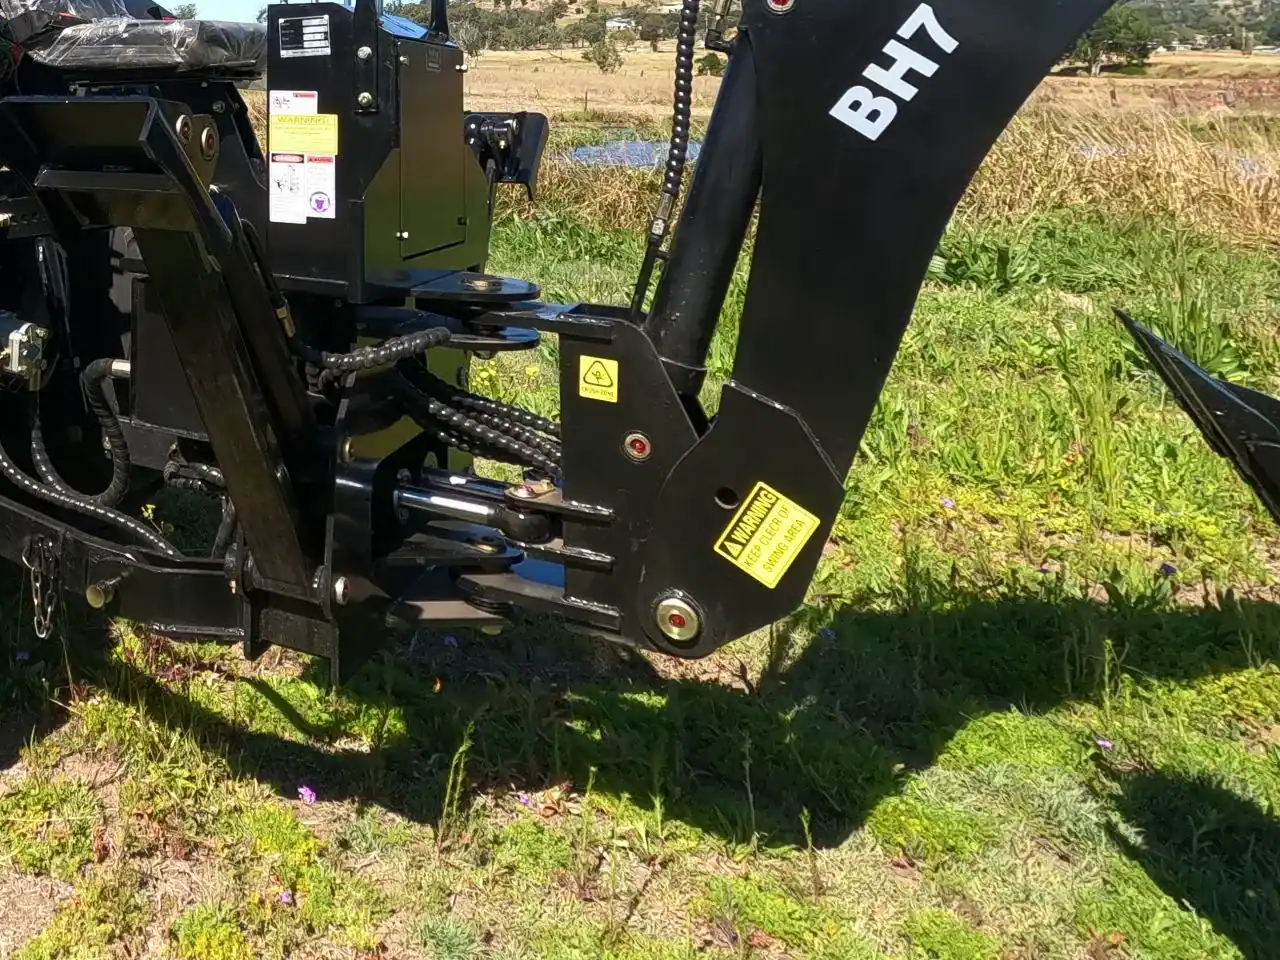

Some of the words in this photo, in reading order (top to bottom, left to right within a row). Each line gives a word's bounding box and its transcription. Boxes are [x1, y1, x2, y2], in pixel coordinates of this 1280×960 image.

[829, 3, 959, 141] BH7
[731, 490, 777, 544] WARNING
[744, 544, 762, 567] KEEP
[763, 542, 789, 573] SWING
[784, 519, 806, 544] AREA
